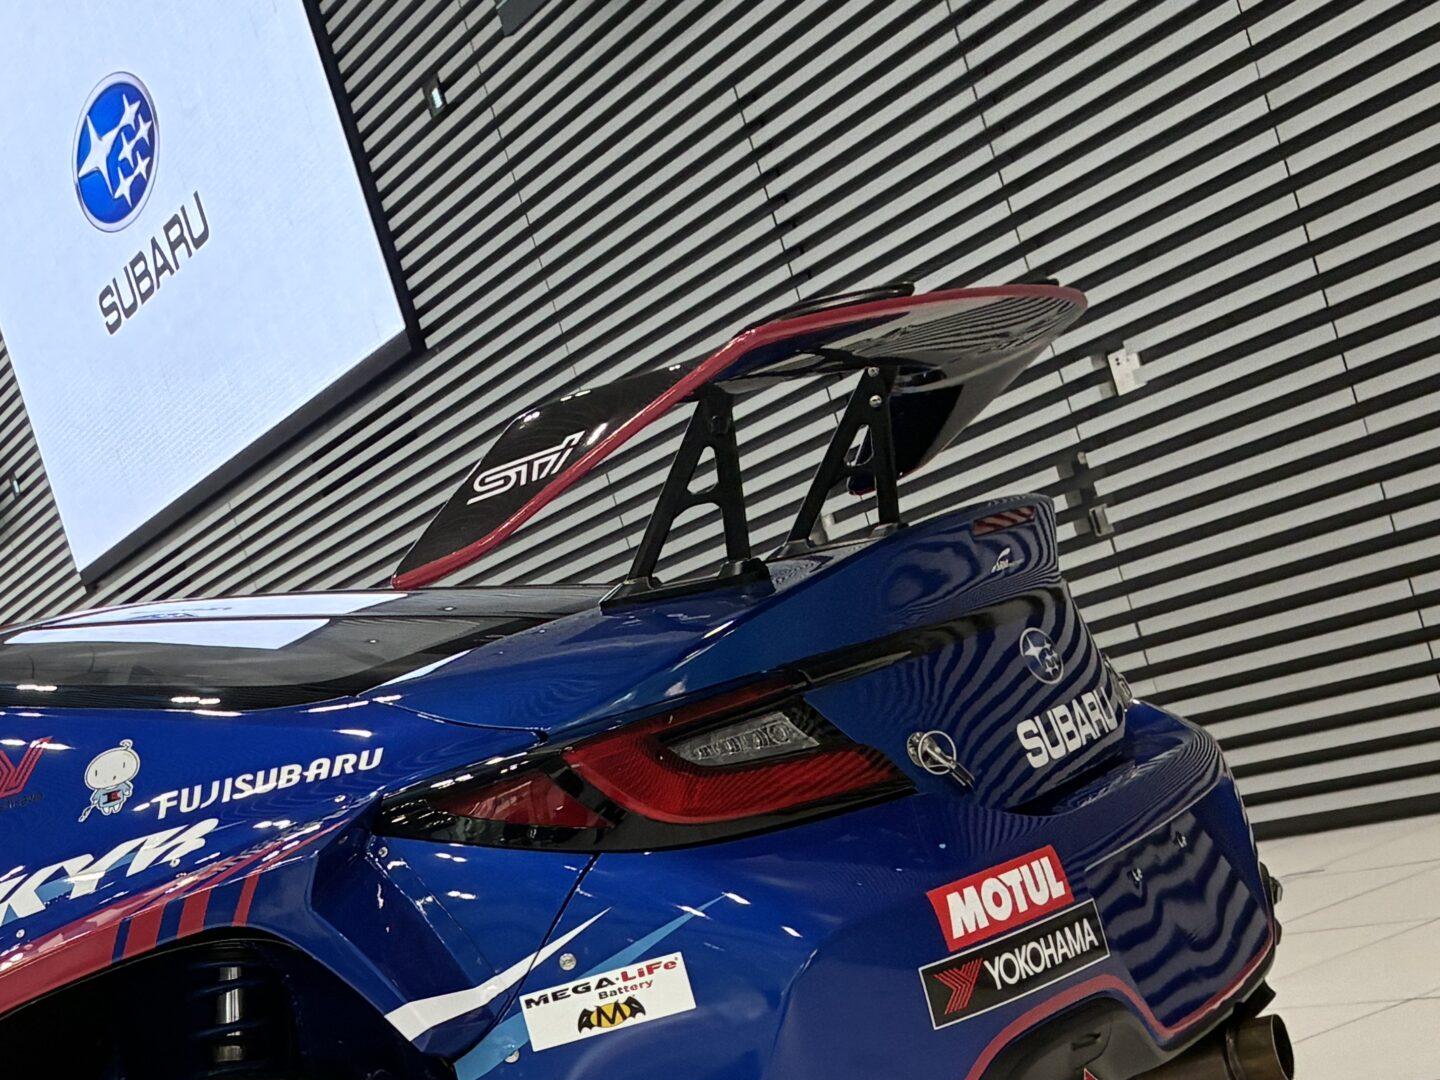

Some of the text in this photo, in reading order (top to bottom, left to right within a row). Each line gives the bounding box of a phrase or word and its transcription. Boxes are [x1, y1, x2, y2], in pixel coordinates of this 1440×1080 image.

[98, 190, 210, 336] SUBARU
[1016, 686, 1117, 769] SUBARU
[153, 746, 385, 820] FUJISUBARU
[946, 855, 1066, 940] MOTUL
[598, 979, 653, 1001] Battery
[983, 918, 1099, 990] YOKOHAMA
